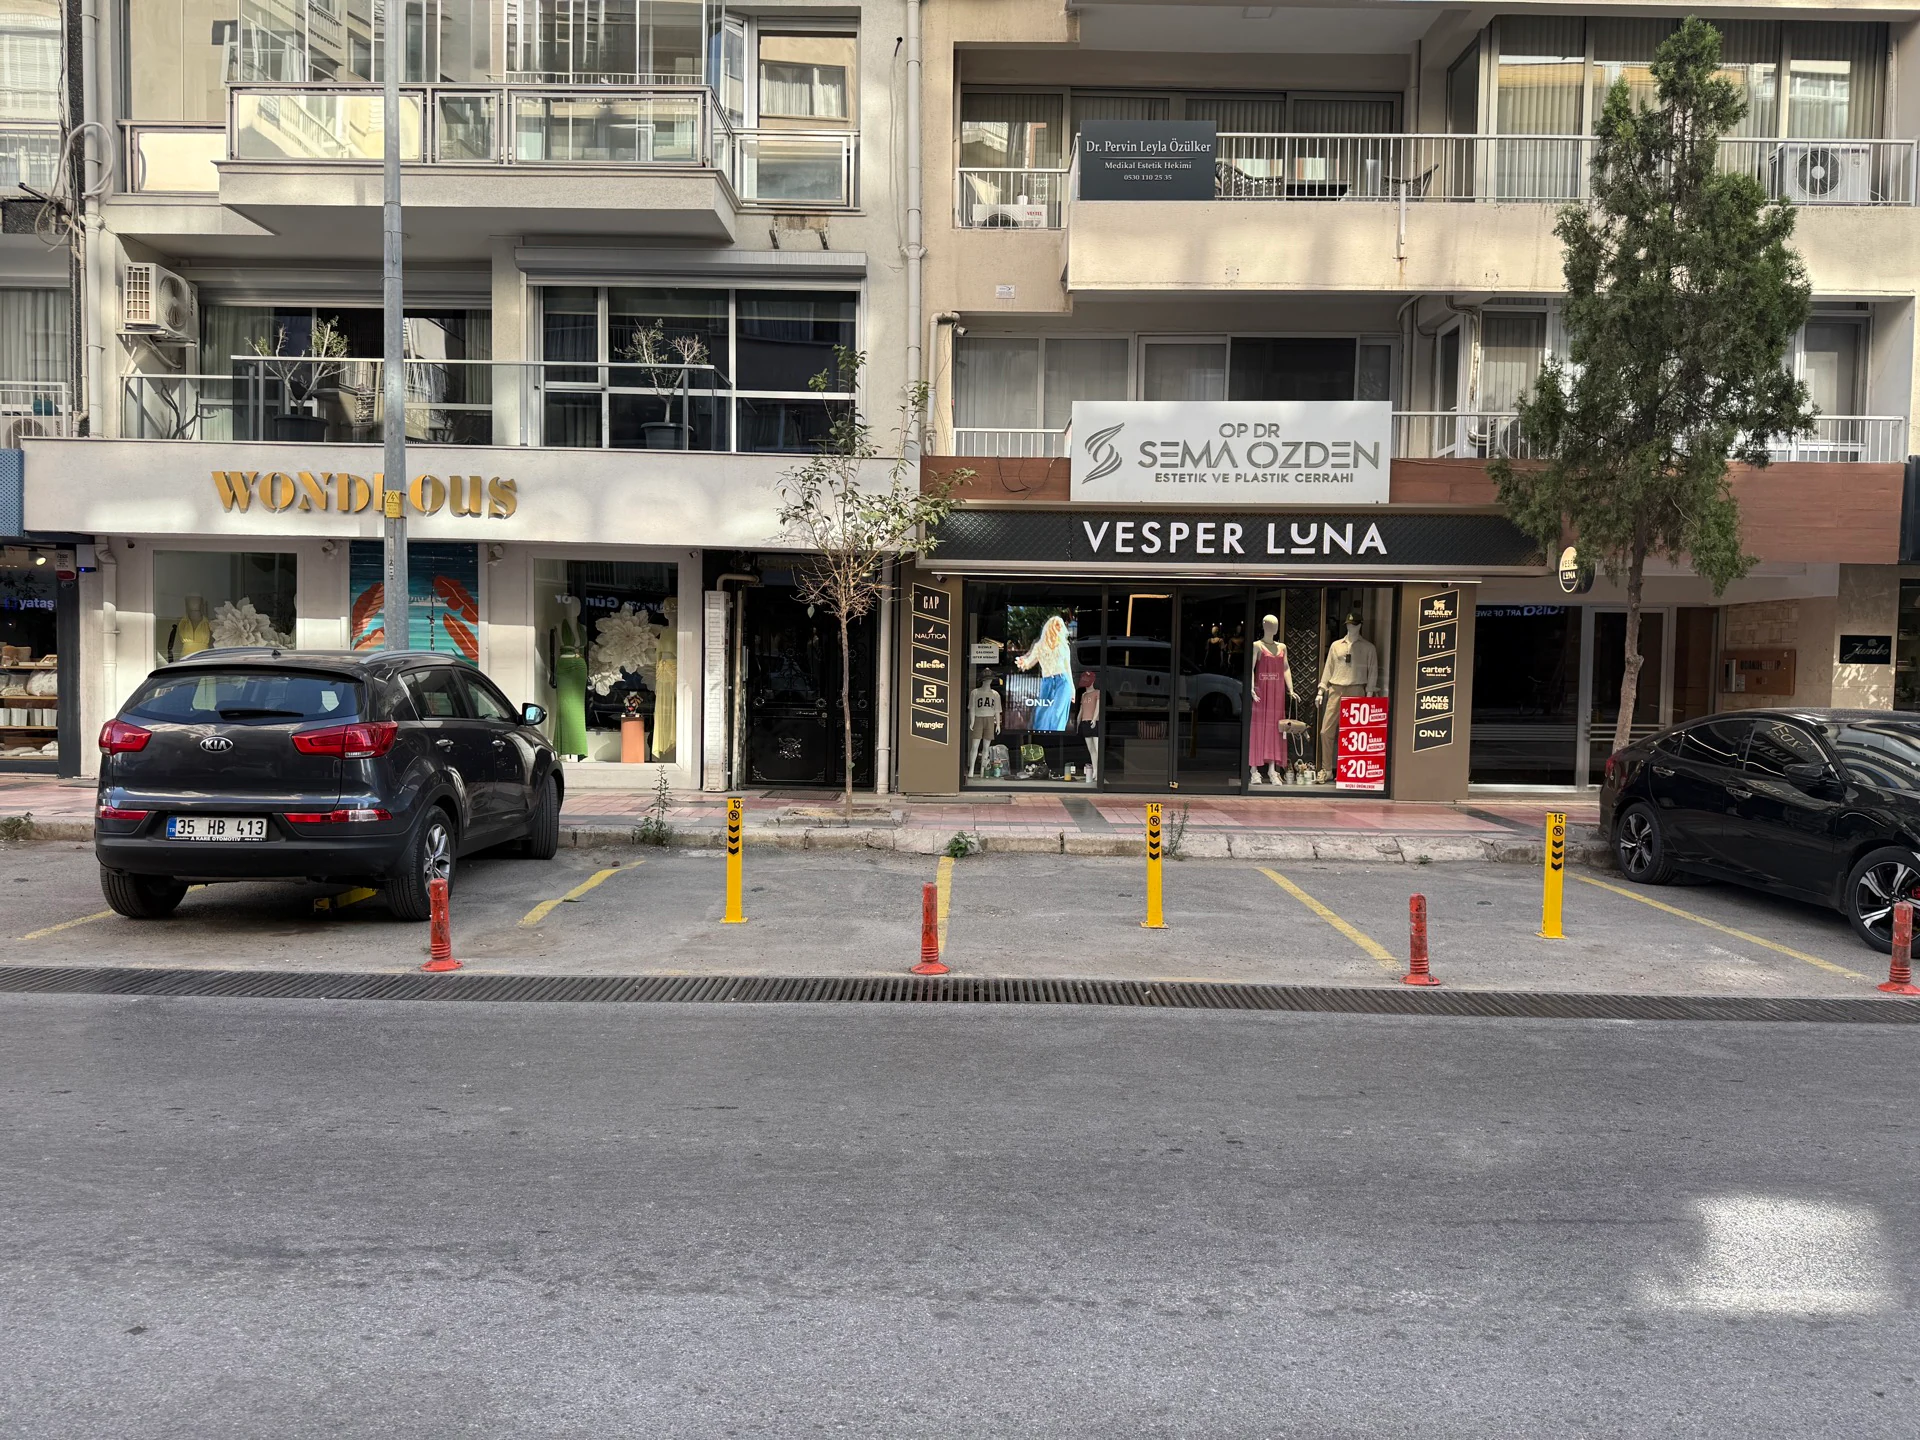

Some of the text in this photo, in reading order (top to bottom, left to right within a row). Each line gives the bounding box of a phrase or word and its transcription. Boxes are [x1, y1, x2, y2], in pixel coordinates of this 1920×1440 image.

[1086, 138, 1211, 155] Dr. Pervin Leyla Özülker
[1104, 161, 1192, 169] Medikal Estetik Hekimi
[1219, 422, 1280, 438] OP DR
[1138, 439, 1239, 469] SEMA
[1212, 473, 1229, 483] VE
[1082, 521, 1388, 555] VESPER LUNA
[923, 595, 940, 609] GAP
[1428, 631, 1446, 645] GAP
[915, 660, 945, 669] ellesse
[1421, 666, 1452, 674] carter's
[1025, 698, 1054, 707] ONLY
[1420, 695, 1449, 703] JACK&
[1420, 702, 1449, 710] JONES
[1341, 703, 1370, 725] %50
[915, 721, 944, 730] Wrangler
[1419, 729, 1447, 738] ONLY
[204, 739, 227, 750] KIA
[1341, 731, 1368, 752] %30
[1340, 759, 1366, 778] %20
[733, 799, 741, 809] 13
[1150, 803, 1160, 813] 14
[1553, 813, 1564, 824] 15
[177, 819, 195, 834] 35
[207, 820, 225, 835] HB
[236, 820, 264, 836] 413
